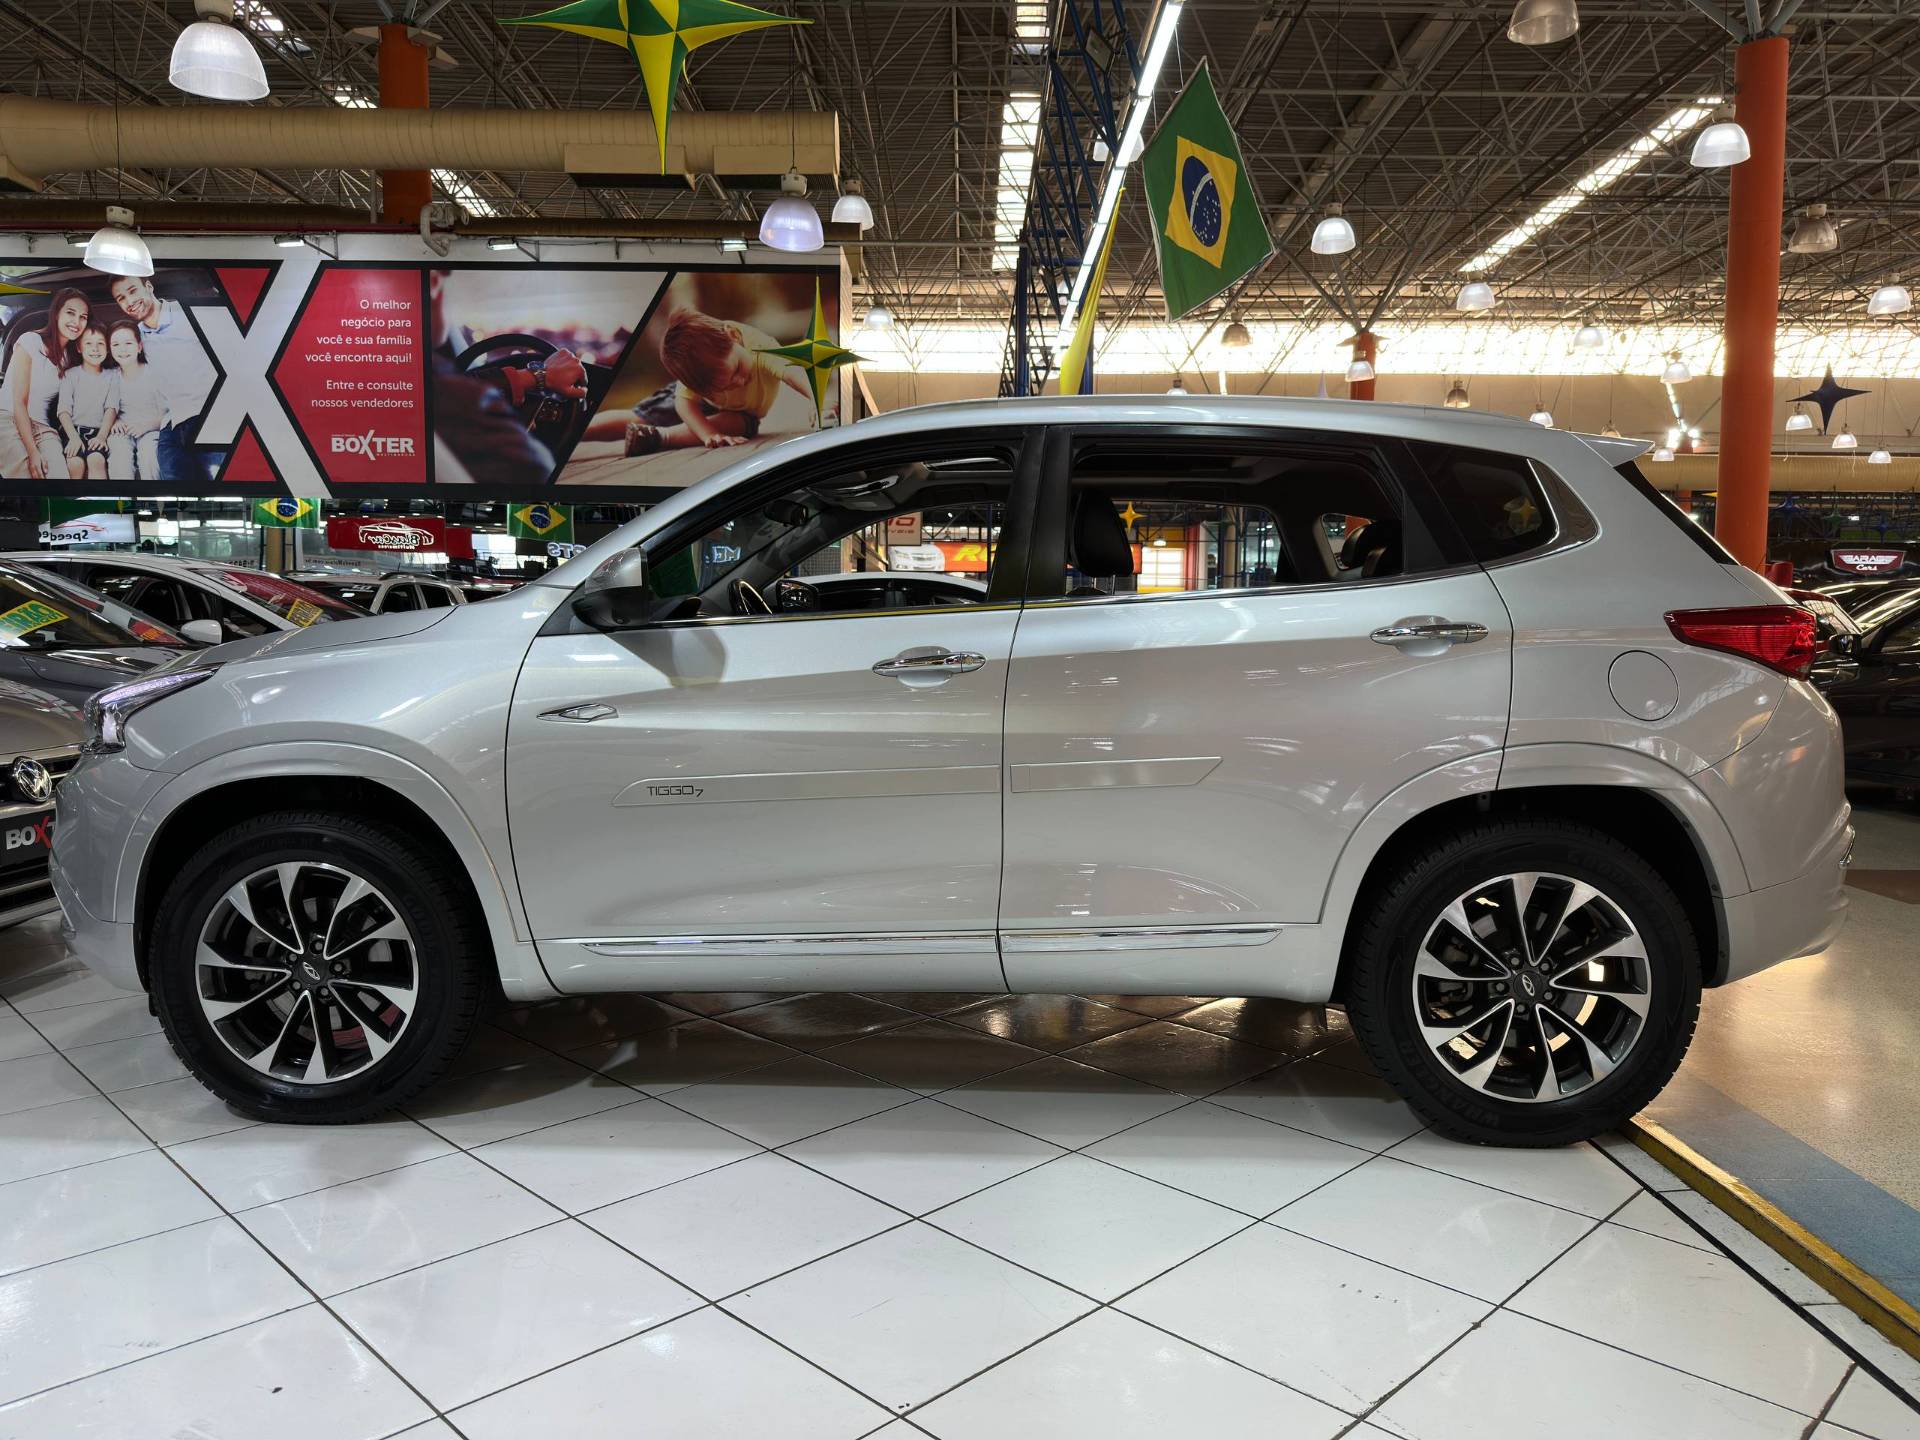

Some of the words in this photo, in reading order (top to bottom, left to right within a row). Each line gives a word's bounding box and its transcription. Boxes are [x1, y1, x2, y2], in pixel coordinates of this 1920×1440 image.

[360, 300, 369, 310] O
[373, 300, 412, 310] melhor
[341, 317, 385, 329] negócio
[388, 319, 412, 329] para
[317, 335, 343, 345] você
[345, 336, 353, 345] e
[355, 336, 373, 345] sua
[376, 335, 412, 345] família
[305, 352, 332, 362] você
[334, 353, 383, 363] encontra
[385, 353, 412, 365] aqui!
[326, 380, 355, 390] Entre
[357, 381, 364, 390] e
[367, 380, 414, 391] consulte
[312, 399, 348, 408] nossos
[351, 398, 414, 409] vendedores
[331, 429, 415, 461] BOXTER
